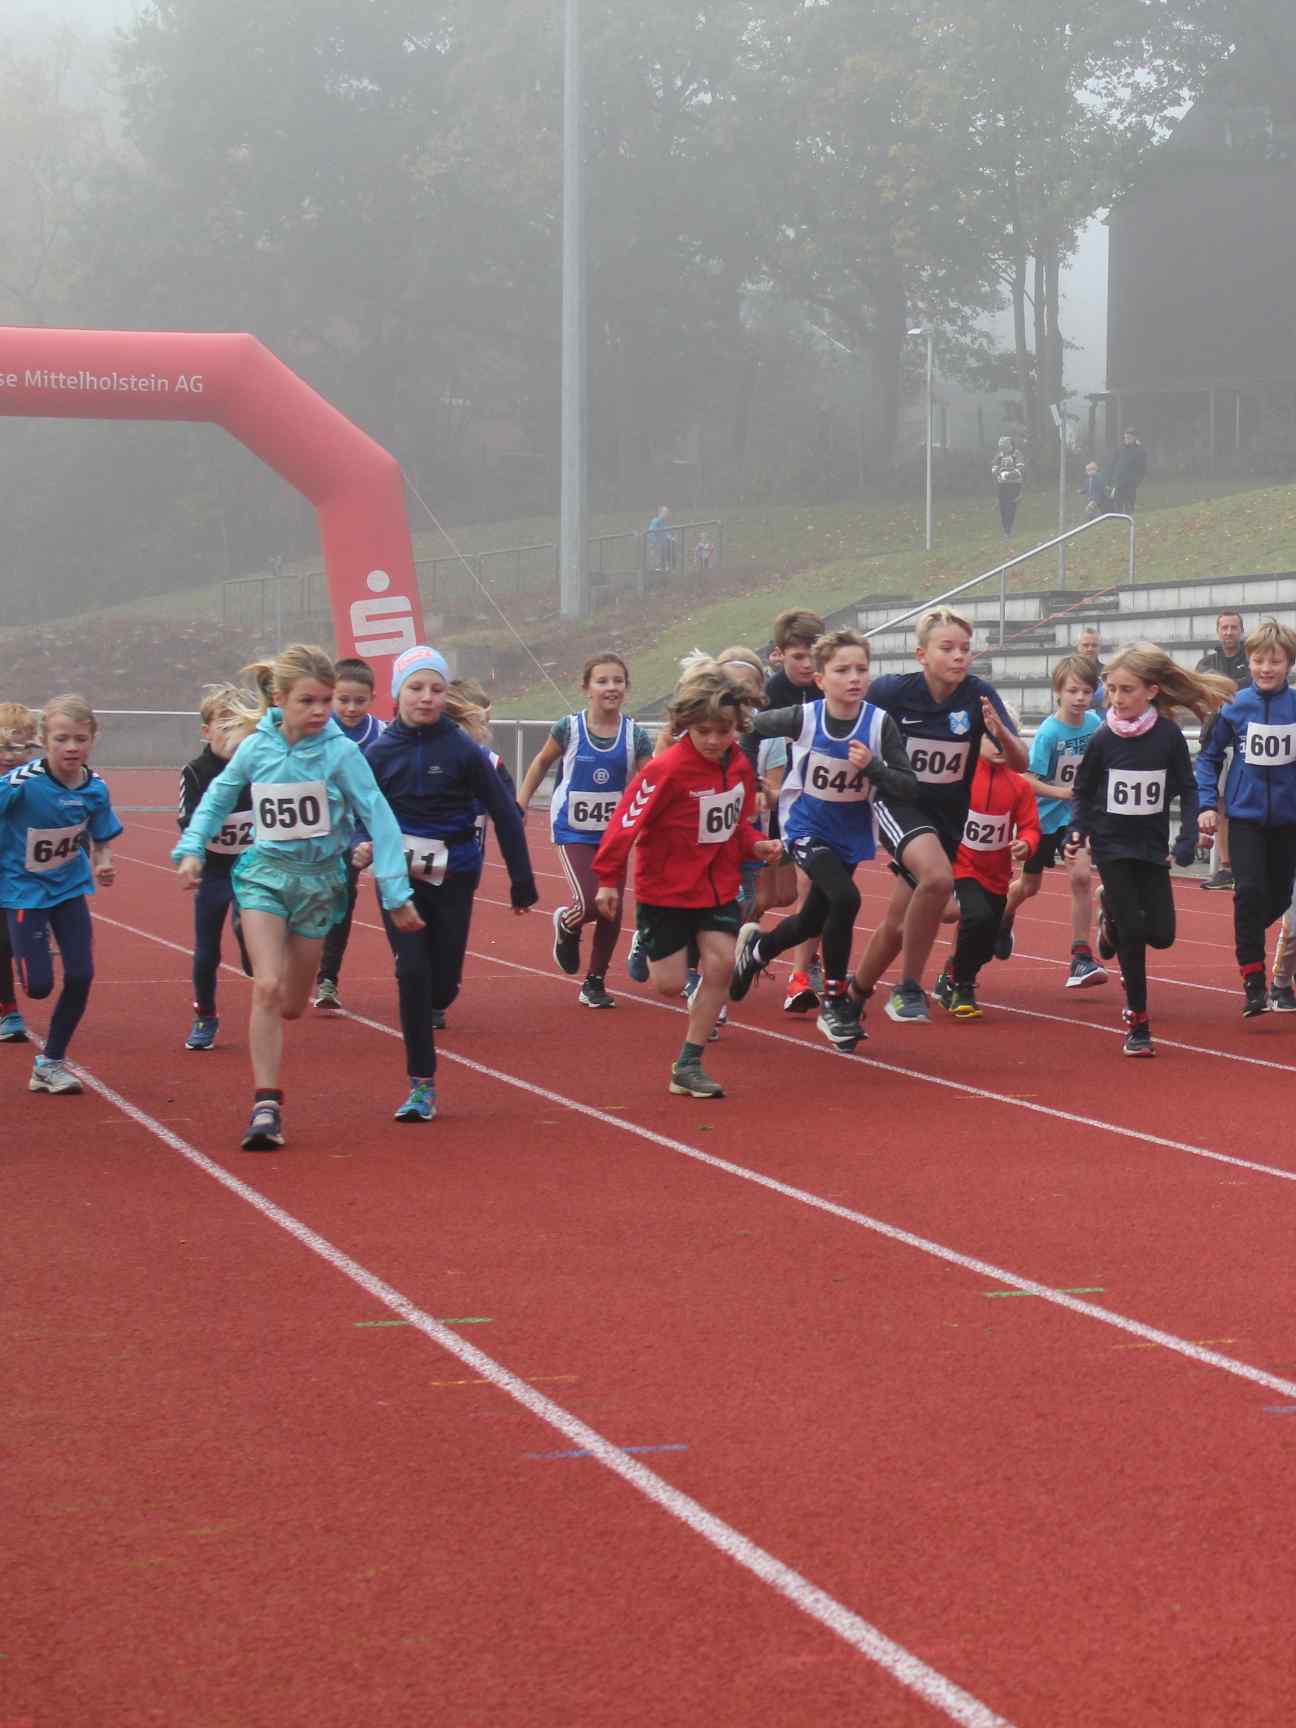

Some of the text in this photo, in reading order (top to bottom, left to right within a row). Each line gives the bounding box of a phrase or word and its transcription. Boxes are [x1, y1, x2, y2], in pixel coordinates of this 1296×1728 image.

[24, 369, 169, 393] Mittelholstein
[175, 375, 203, 393] AG
[1250, 734, 1291, 757] 601
[911, 749, 963, 774] 604
[812, 765, 864, 793] 644
[1113, 781, 1161, 806] 619
[260, 795, 320, 829] 650
[211, 822, 254, 846] 52
[966, 821, 1005, 844] 621
